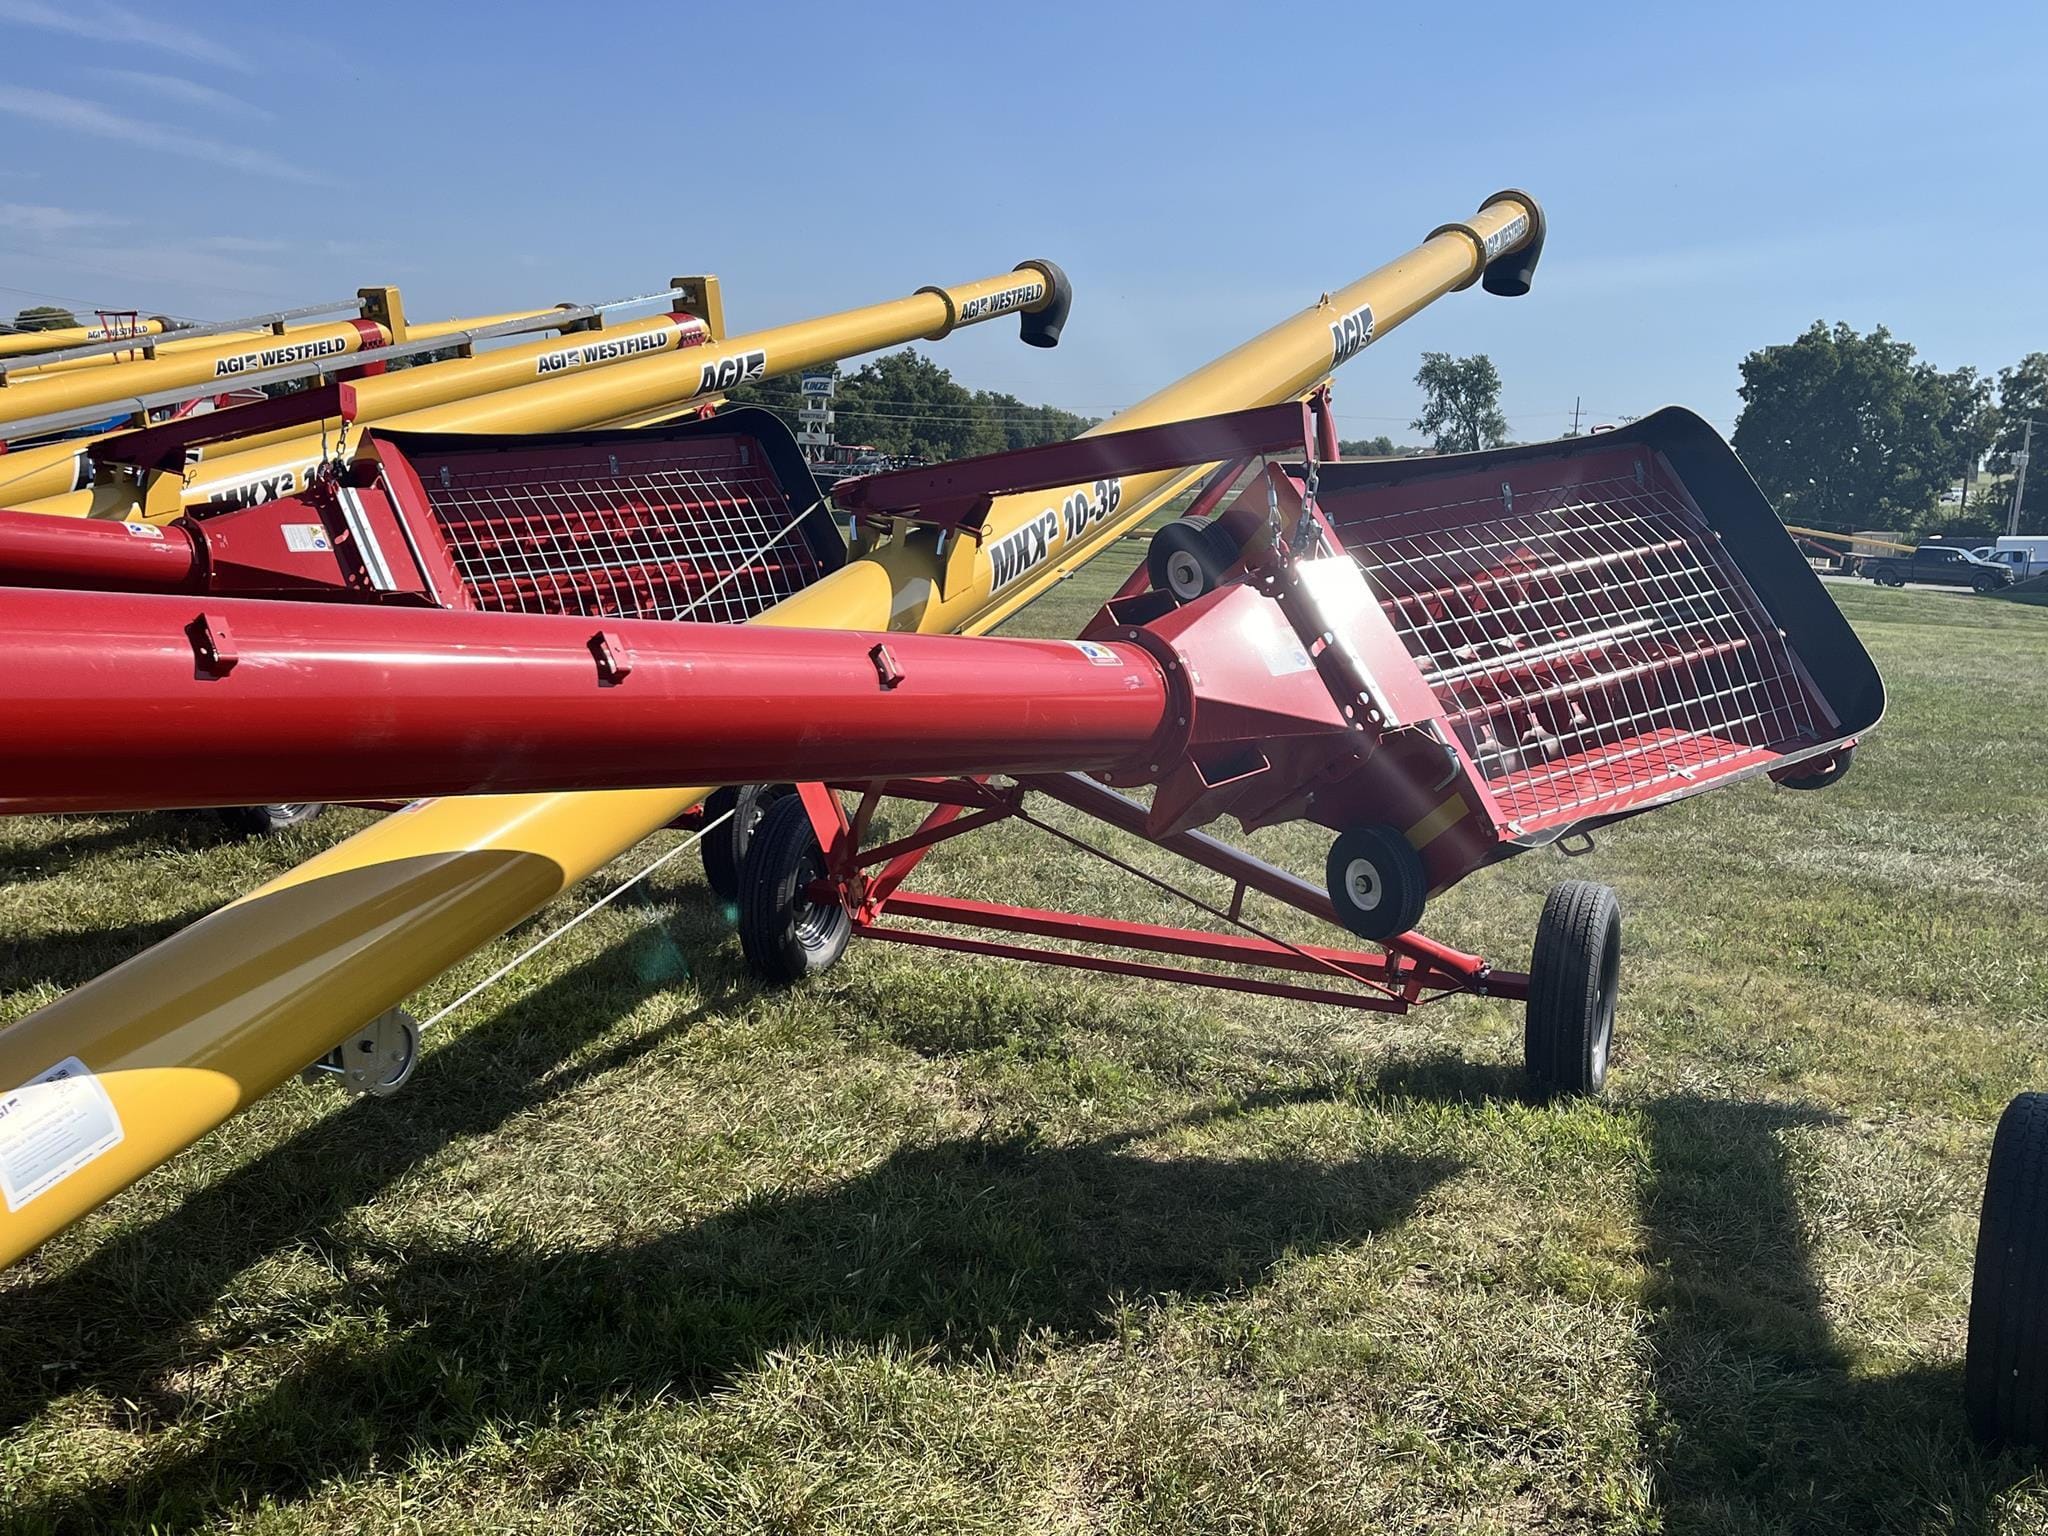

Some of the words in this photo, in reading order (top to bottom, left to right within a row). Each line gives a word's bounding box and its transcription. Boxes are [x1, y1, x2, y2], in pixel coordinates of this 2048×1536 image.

[960, 301, 979, 321] AGI
[990, 284, 1043, 312] WESTFIELD
[88, 330, 101, 339] AGI
[109, 326, 148, 337] WESTFELD
[1327, 314, 1361, 372] AGI
[216, 357, 244, 375] AGI
[261, 338, 345, 366] WESTFIELD
[538, 354, 566, 373] AGI
[583, 333, 667, 362] WESTFIELD
[692, 357, 743, 397] AGI
[803, 382, 829, 390] KINZE
[1064, 478, 1121, 542] 10-36
